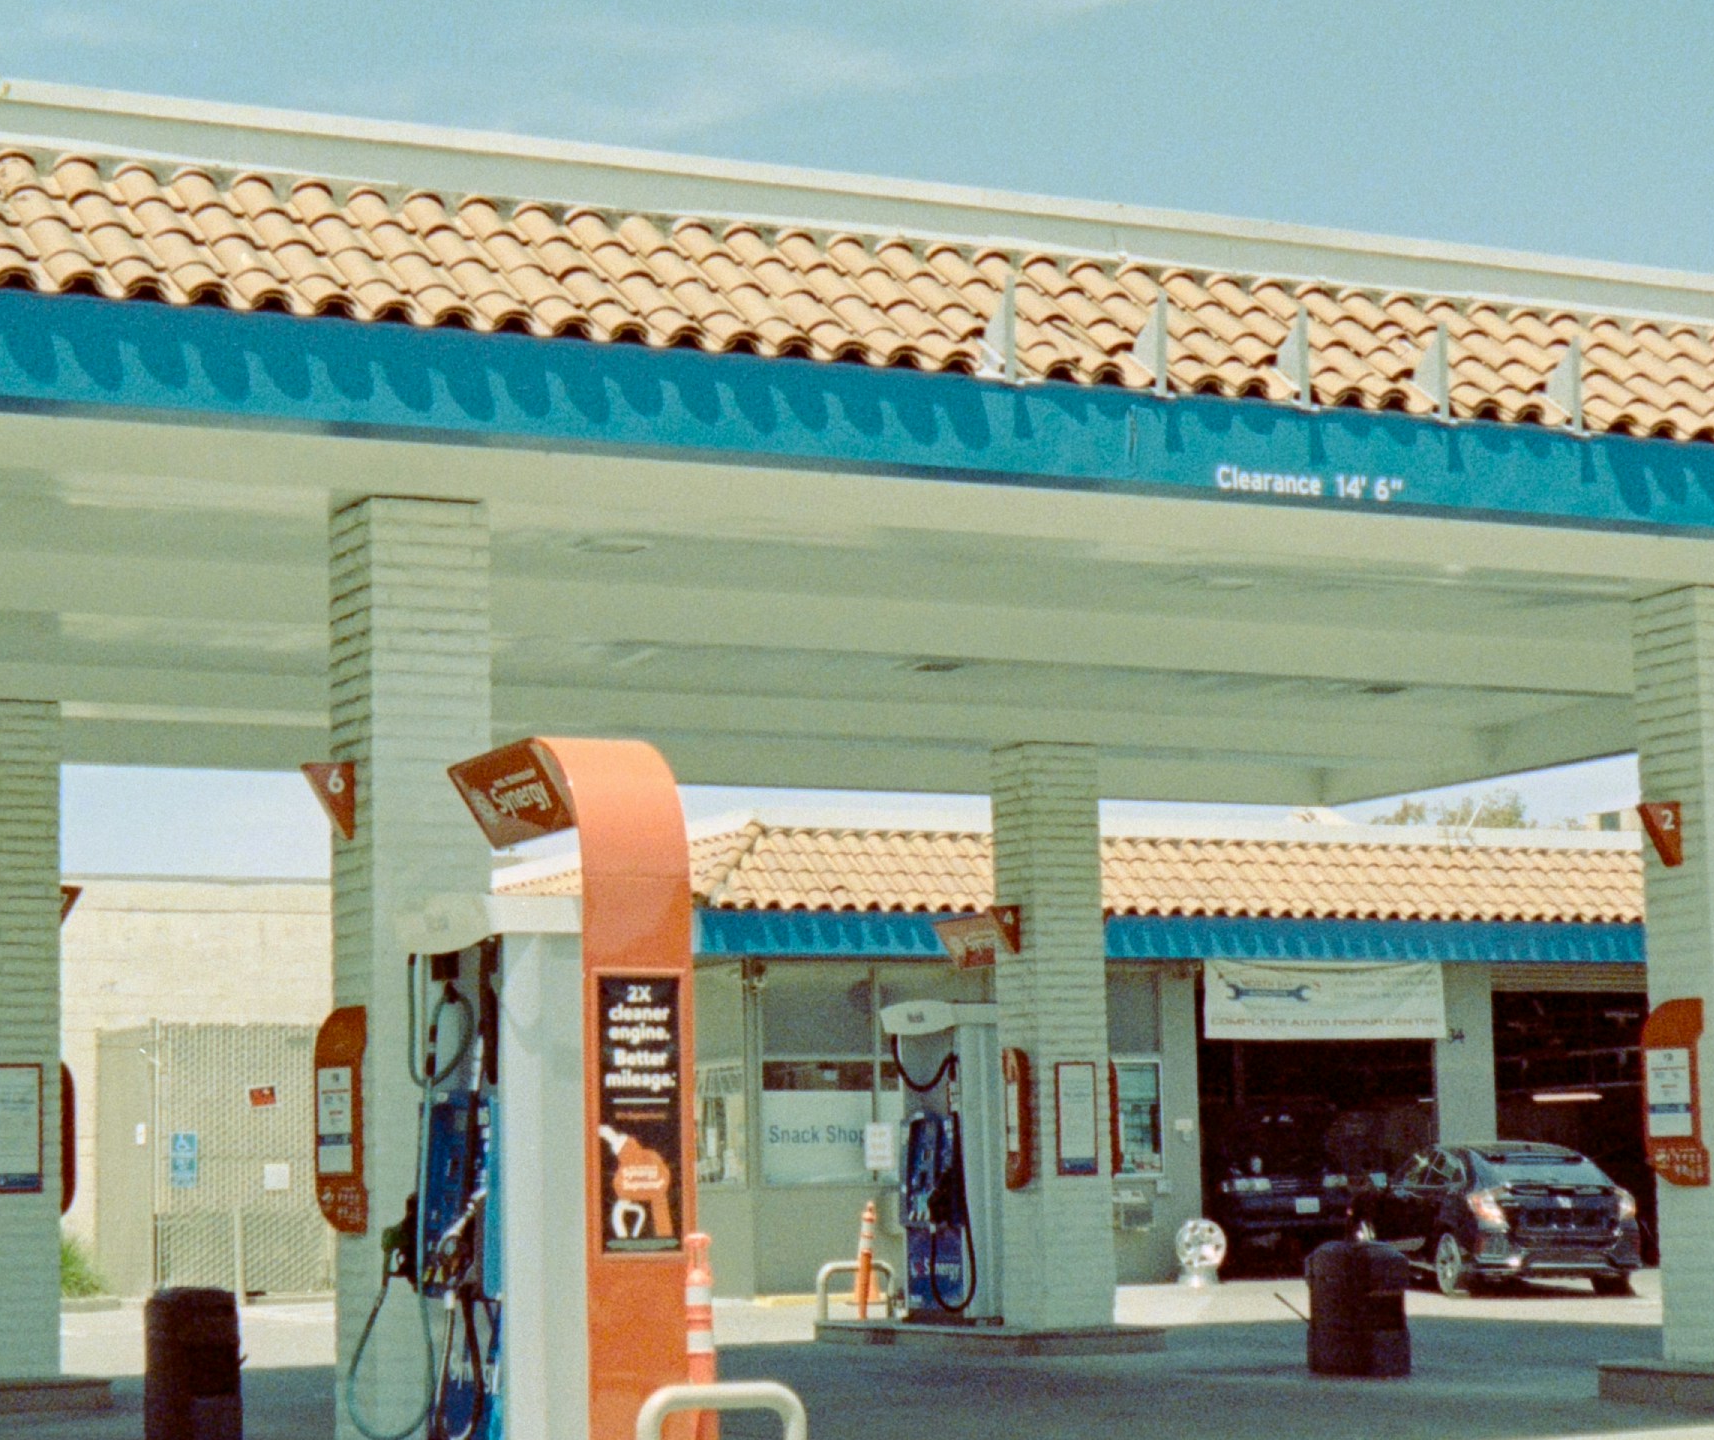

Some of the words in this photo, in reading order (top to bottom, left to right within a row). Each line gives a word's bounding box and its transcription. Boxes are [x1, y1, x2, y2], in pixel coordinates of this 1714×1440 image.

[1215, 464, 1323, 496] Clearance
[1335, 473, 1367, 499] 14'
[327, 768, 346, 794] 6
[489, 779, 554, 819] Synergy
[1660, 808, 1676, 832] 2
[626, 984, 652, 1003] 2X
[607, 1001, 671, 1022] cleaner
[607, 1021, 672, 1046] engine.
[612, 1047, 670, 1067] Better
[768, 1124, 820, 1145] Snack
